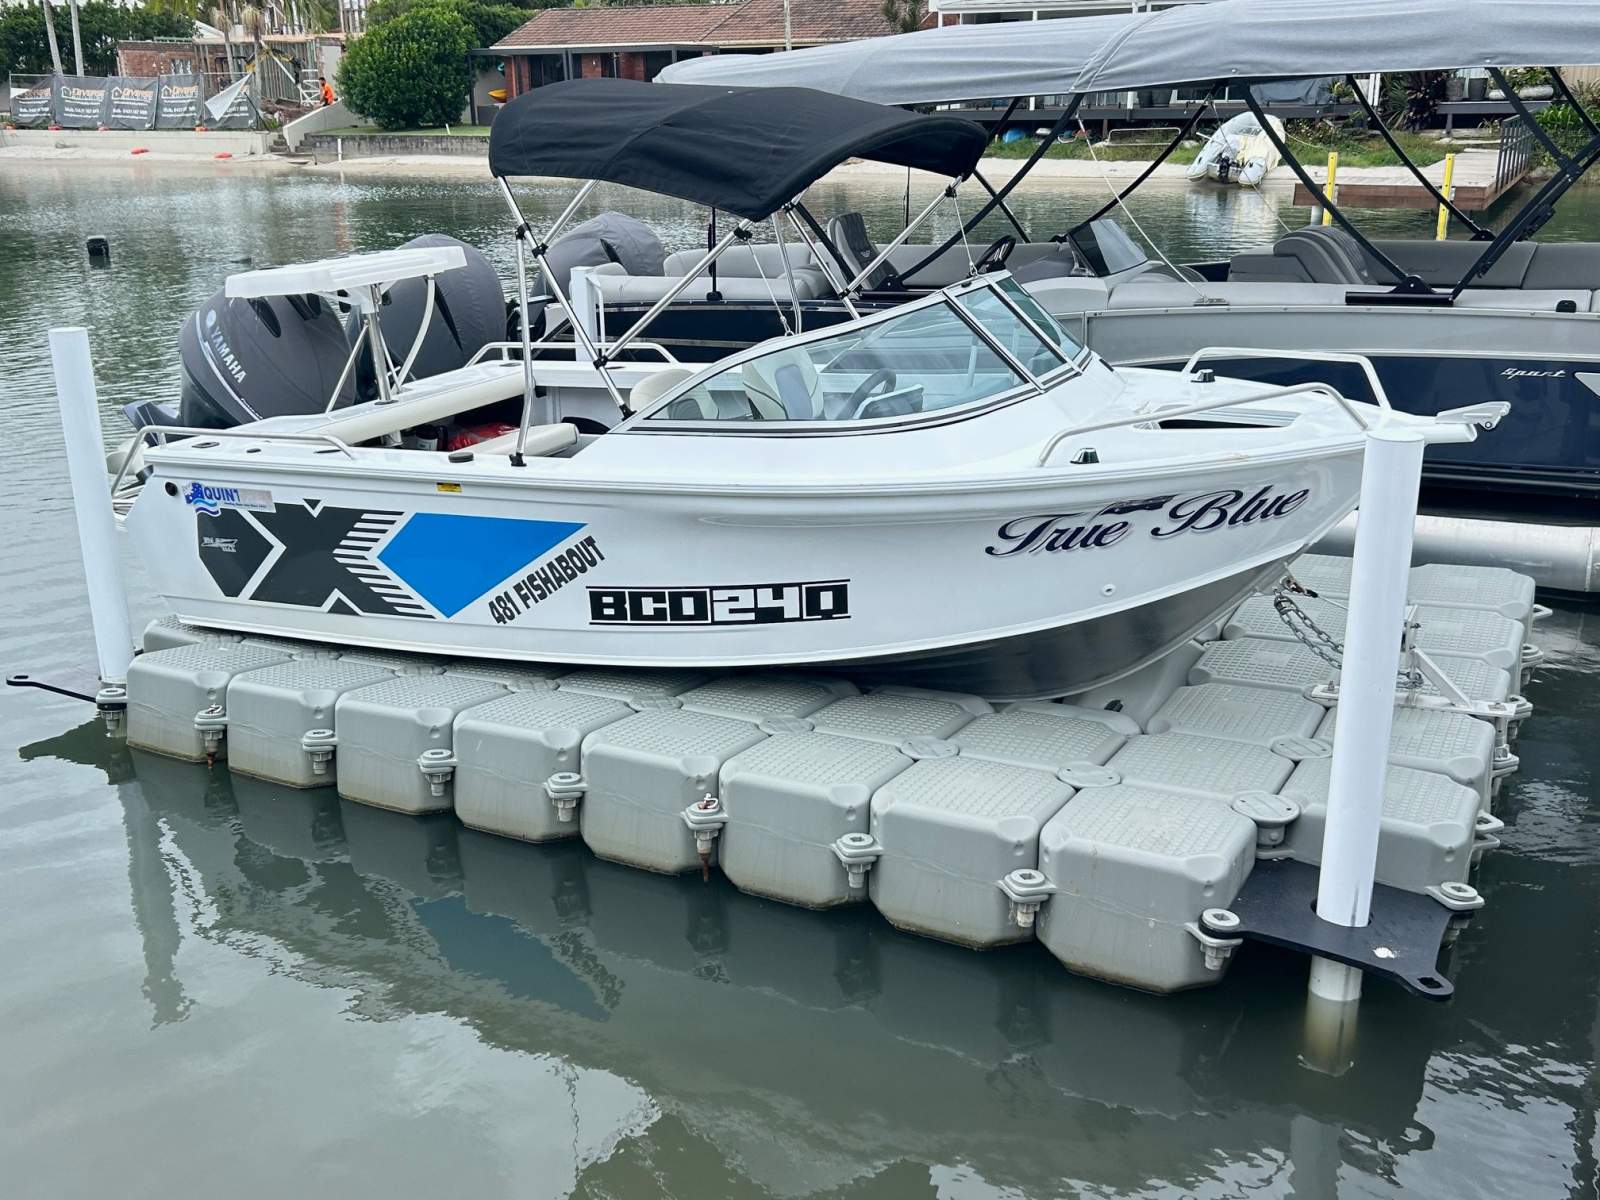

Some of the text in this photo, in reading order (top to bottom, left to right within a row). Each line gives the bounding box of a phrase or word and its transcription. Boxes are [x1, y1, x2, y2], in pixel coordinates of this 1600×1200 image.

[210, 326, 248, 384] YAMAHA
[1500, 367, 1566, 380] Sport
[985, 485, 1310, 557] True Blue
[488, 535, 605, 625] 481 FISHABOUT
